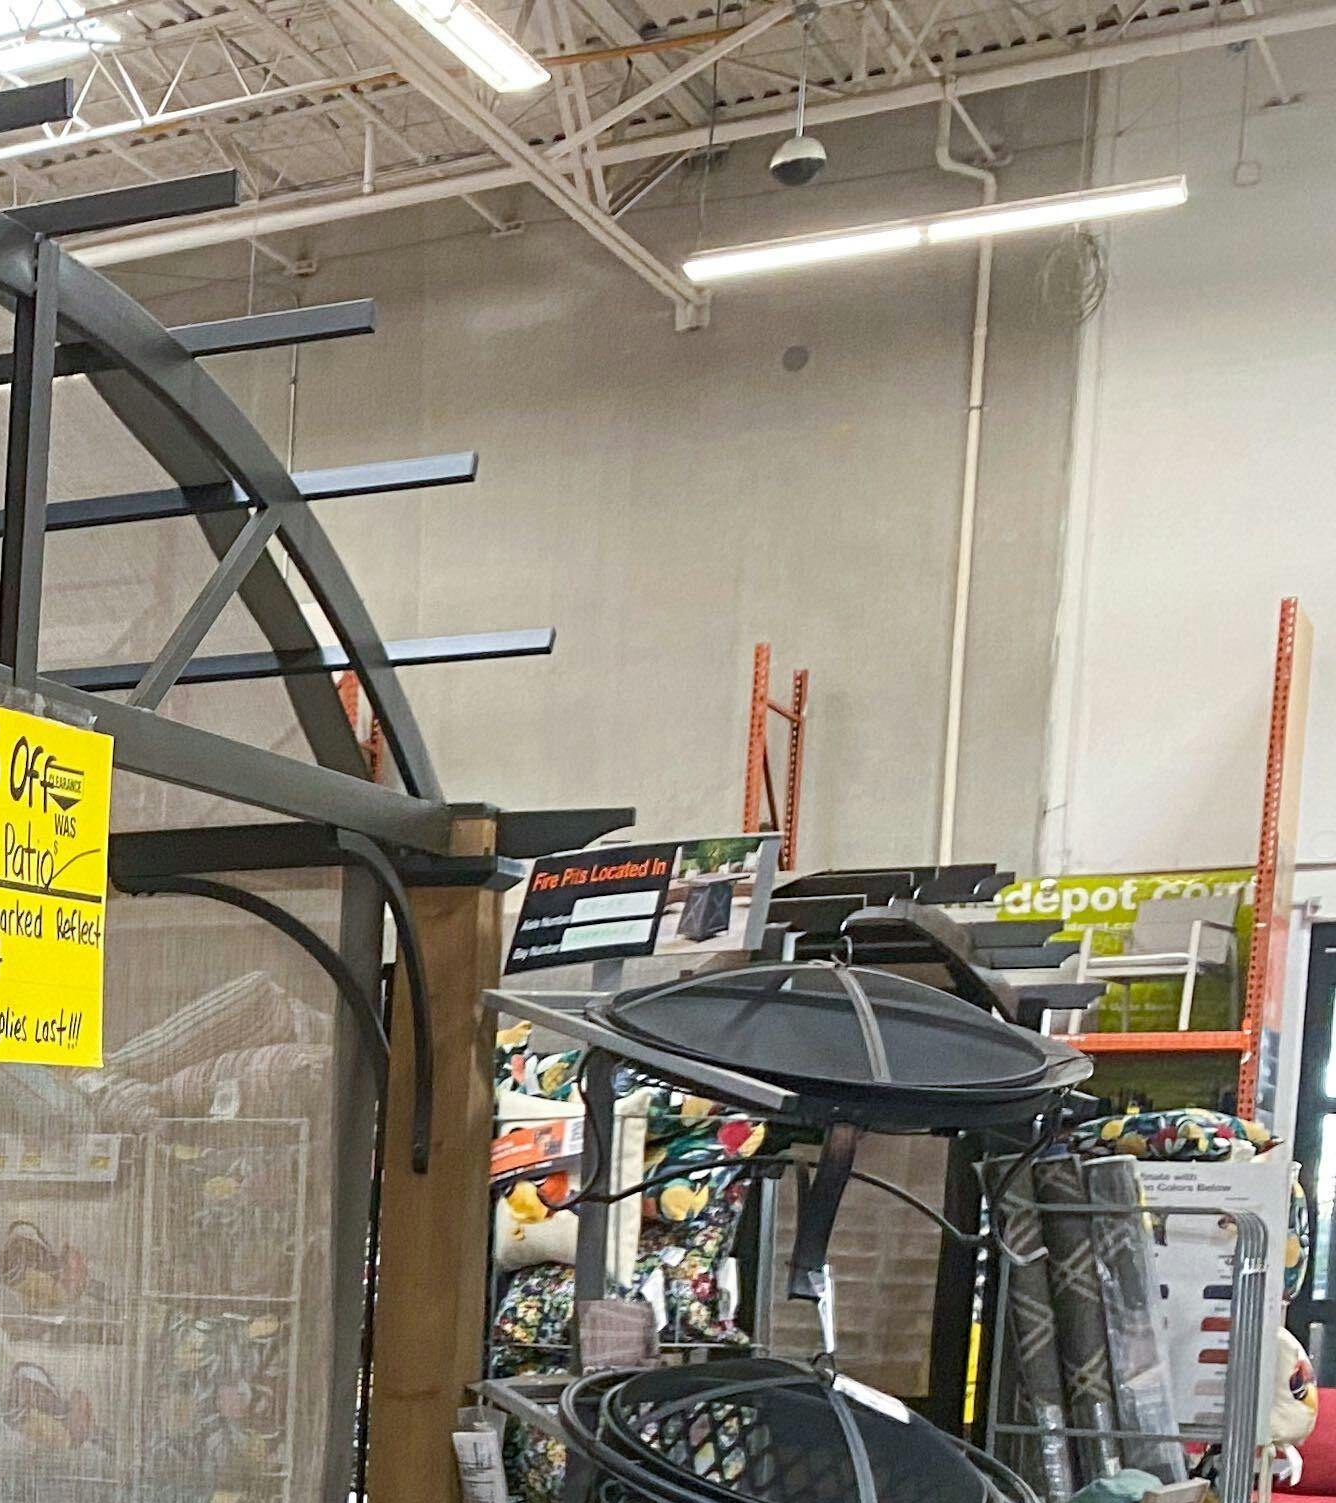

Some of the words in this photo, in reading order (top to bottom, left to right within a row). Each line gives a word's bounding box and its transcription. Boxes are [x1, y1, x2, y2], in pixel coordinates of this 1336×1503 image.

[10, 736, 57, 813] Off
[54, 814, 77, 838] WAS
[4, 821, 55, 891] Patio
[532, 872, 560, 892] Fire
[561, 867, 589, 888] Pits
[590, 859, 650, 883] Located
[651, 857, 668, 876] In
